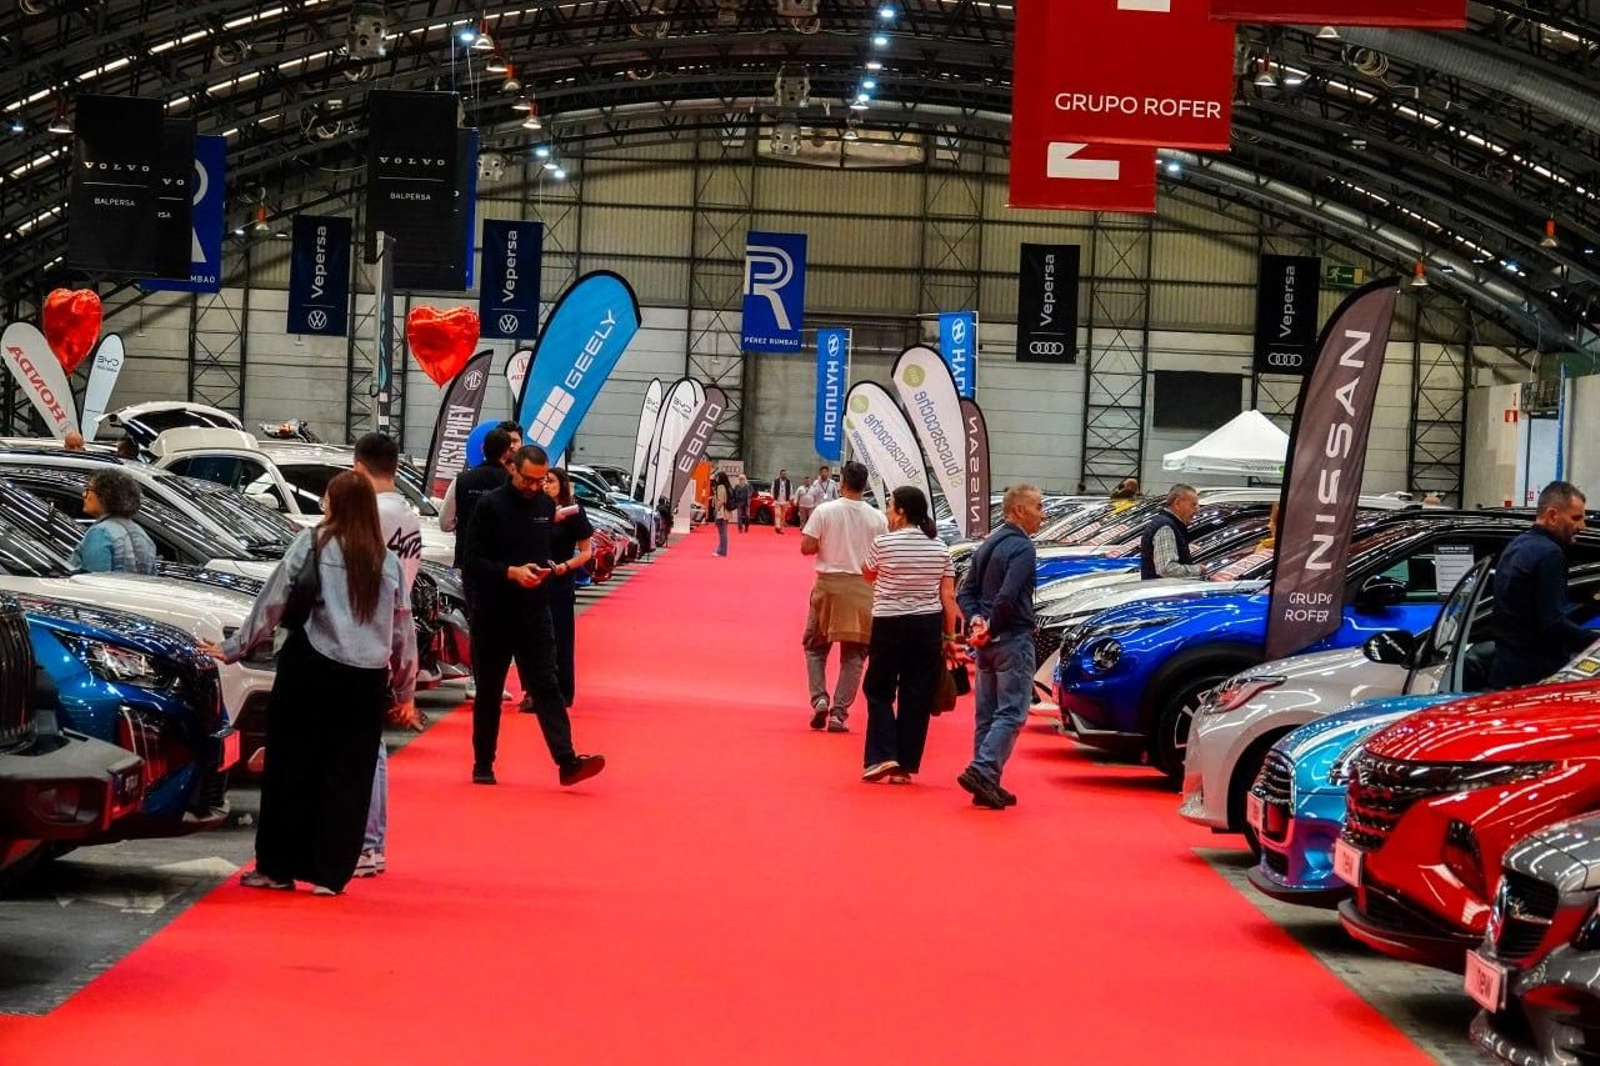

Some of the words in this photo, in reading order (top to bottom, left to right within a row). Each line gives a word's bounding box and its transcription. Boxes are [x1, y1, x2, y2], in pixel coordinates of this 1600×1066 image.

[1055, 92, 1138, 115] GRUPO
[1144, 97, 1221, 119] ROFER
[83, 161, 150, 172] VOLVO
[380, 156, 446, 166] VOLVO
[94, 197, 136, 207] BALPERSA
[390, 191, 431, 201] BALPERSA
[190, 274, 216, 284] MBAO
[310, 225, 328, 299] Vepersa
[502, 229, 519, 303] Vepersa
[1039, 253, 1056, 327] Vepersa
[1279, 264, 1297, 338] Vepersa
[564, 309, 616, 390] GEELY
[443, 404, 476, 438] PHEV
[678, 403, 722, 474] EBRO
[1304, 329, 1371, 571] NISSAN
[1284, 609, 1330, 623] ROFER
